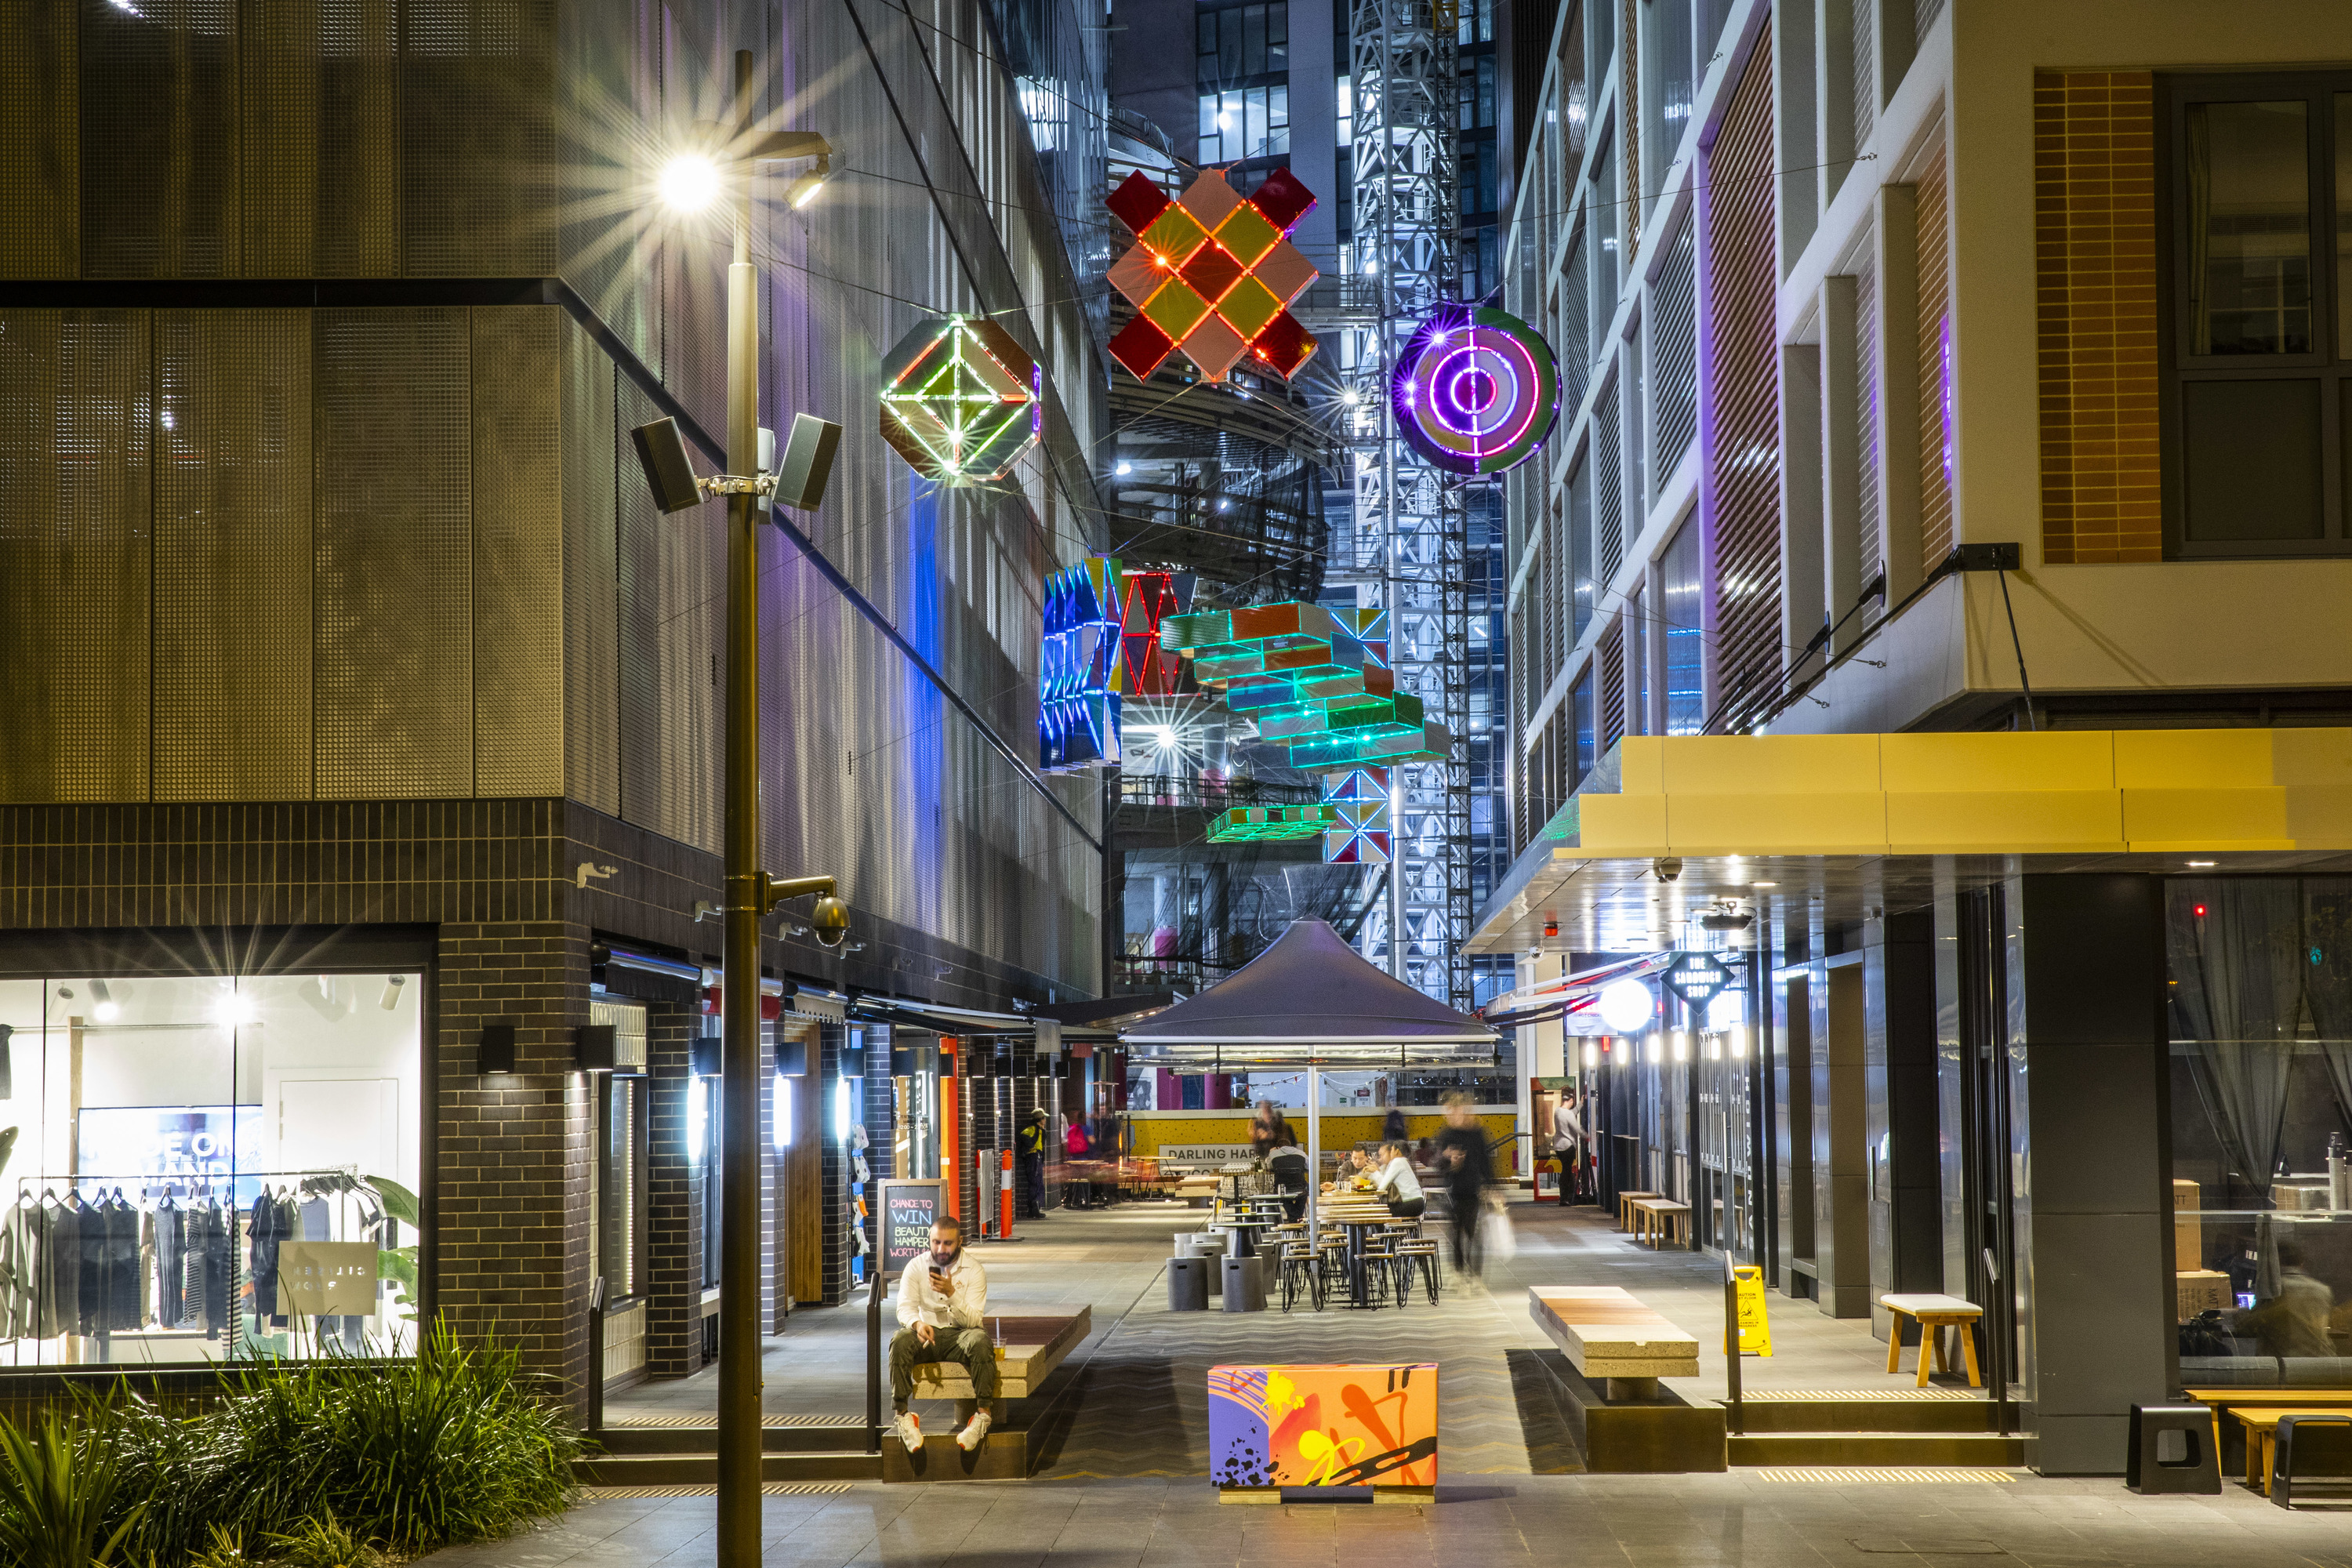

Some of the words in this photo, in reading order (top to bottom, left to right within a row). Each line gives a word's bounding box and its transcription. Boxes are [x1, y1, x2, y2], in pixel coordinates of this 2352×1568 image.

[1689, 957, 1705, 970] THE
[1675, 971, 1721, 984] SANDWICH
[1687, 985, 1710, 997] SHOP
[1168, 1149, 1225, 1160] DARLING
[1230, 1149, 1255, 1160] HAR
[1744, 1076, 1755, 1250] SANDWICH
[890, 1199, 919, 1208] CHANCE
[920, 1200, 933, 1209] TO
[2174, 1195, 2186, 1205] ATT
[892, 1210, 932, 1225] WIN
[895, 1226, 931, 1236] BEAUTY
[895, 1237, 930, 1247] HAMPER
[890, 1247, 920, 1257] WORTH
